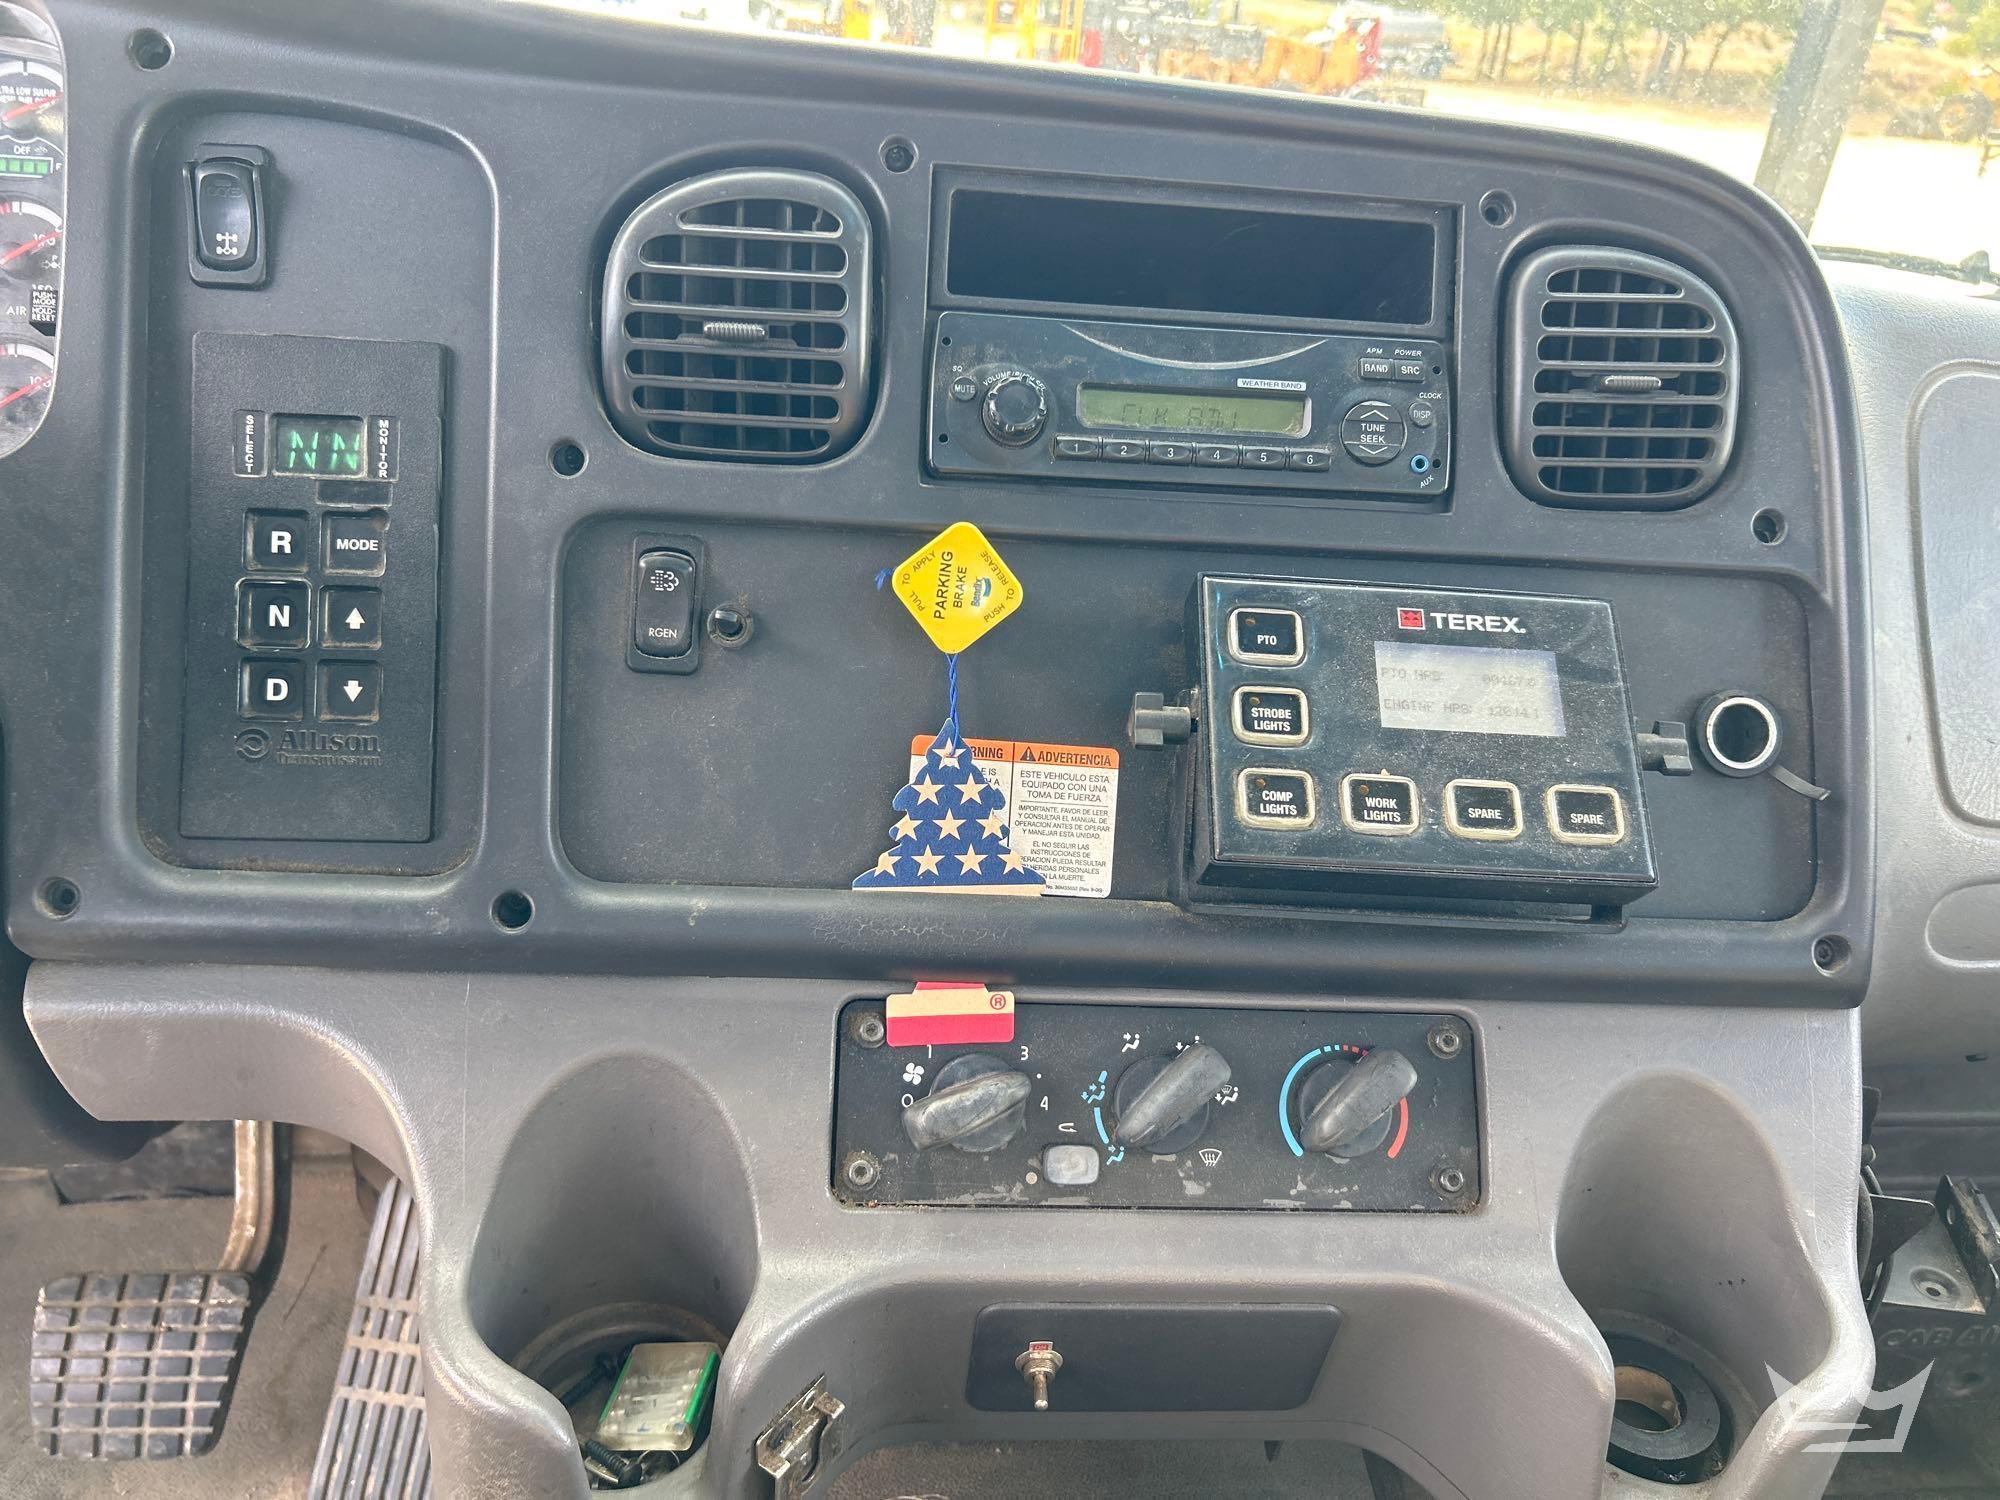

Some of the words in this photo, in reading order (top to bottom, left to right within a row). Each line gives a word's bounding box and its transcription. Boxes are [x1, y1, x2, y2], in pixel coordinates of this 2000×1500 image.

[14, 145, 31, 155] DEF
[6, 305, 27, 316] AIR
[32, 314, 56, 322] RESET
[1394, 349, 1422, 357] POWER
[1364, 363, 1388, 373] BAND
[1401, 366, 1420, 374] SRC
[954, 384, 976, 394] MUTE
[1241, 380, 1280, 388] WEATHER
[1281, 382, 1302, 390] BAND
[1413, 410, 1431, 419] DISP
[1361, 423, 1386, 433] TUNE
[246, 415, 254, 473] SELECT
[1360, 435, 1386, 444] SEEK
[378, 419, 389, 478] MONITOR
[1120, 445, 1128, 455] 2
[1167, 448, 1174, 458] 3
[1213, 450, 1220, 460] 4
[1260, 452, 1267, 462] 5
[1306, 455, 1313, 465] 6
[1420, 474, 1434, 489] AUX
[270, 530, 292, 554] R
[336, 538, 379, 552] MODE
[912, 550, 936, 572] APPLY
[980, 550, 1009, 586] RELEASE
[902, 573, 911, 585] TO
[933, 551, 953, 619] PARKING
[953, 566, 967, 608] BRAKE
[1006, 588, 1015, 600] TO
[910, 590, 925, 611] PULL
[269, 604, 291, 628] N
[983, 603, 1006, 623] PUSH
[1430, 612, 1522, 633] TEREX
[648, 627, 678, 638] RGEN
[1257, 634, 1277, 645] PTO
[266, 678, 288, 701] D
[1251, 707, 1292, 720] STROBE
[1254, 720, 1291, 732] LIGHTS
[279, 729, 381, 751] Allison
[972, 746, 1004, 759] RNING
[1037, 750, 1112, 766] ADVERTENCIA
[988, 768, 997, 776] IS
[1020, 770, 1041, 779] ESTE
[1043, 771, 1086, 782] VEHICULO
[1088, 775, 1110, 783] ESTA
[1021, 781, 1065, 790] EQUIPADO
[1067, 783, 1087, 792] CON
[1088, 784, 1107, 793] UNA
[1027, 790, 1052, 799] TOMA
[1054, 791, 1066, 800] DE
[1068, 792, 1102, 802] FUERZA
[1262, 790, 1293, 802] COMP
[1365, 796, 1398, 809] WORK
[1060, 807, 1081, 815] FAVOR
[1260, 803, 1297, 815] LIGHTS
[1468, 807, 1502, 820] SPARE
[1024, 812, 1060, 821] CONSULTAR
[1363, 809, 1401, 822] LIGHTS
[1570, 812, 1605, 825] SPARE
[1014, 820, 1052, 828] OPERACION
[1053, 822, 1073, 830] ANTES
[1084, 824, 1110, 832] OPERAR
[1028, 828, 1058, 836] MANEJAR
[1053, 842, 1076, 850] SEGUIR
[1030, 849, 1081, 858] INSTRUCCIONES
[1074, 859, 1107, 867] RESULTAR
[1058, 866, 1100, 875] PERSONALES
[926, 1044, 932, 1059] 1
[1020, 1046, 1029, 1061] 3
[1040, 1096, 1049, 1111] 4
